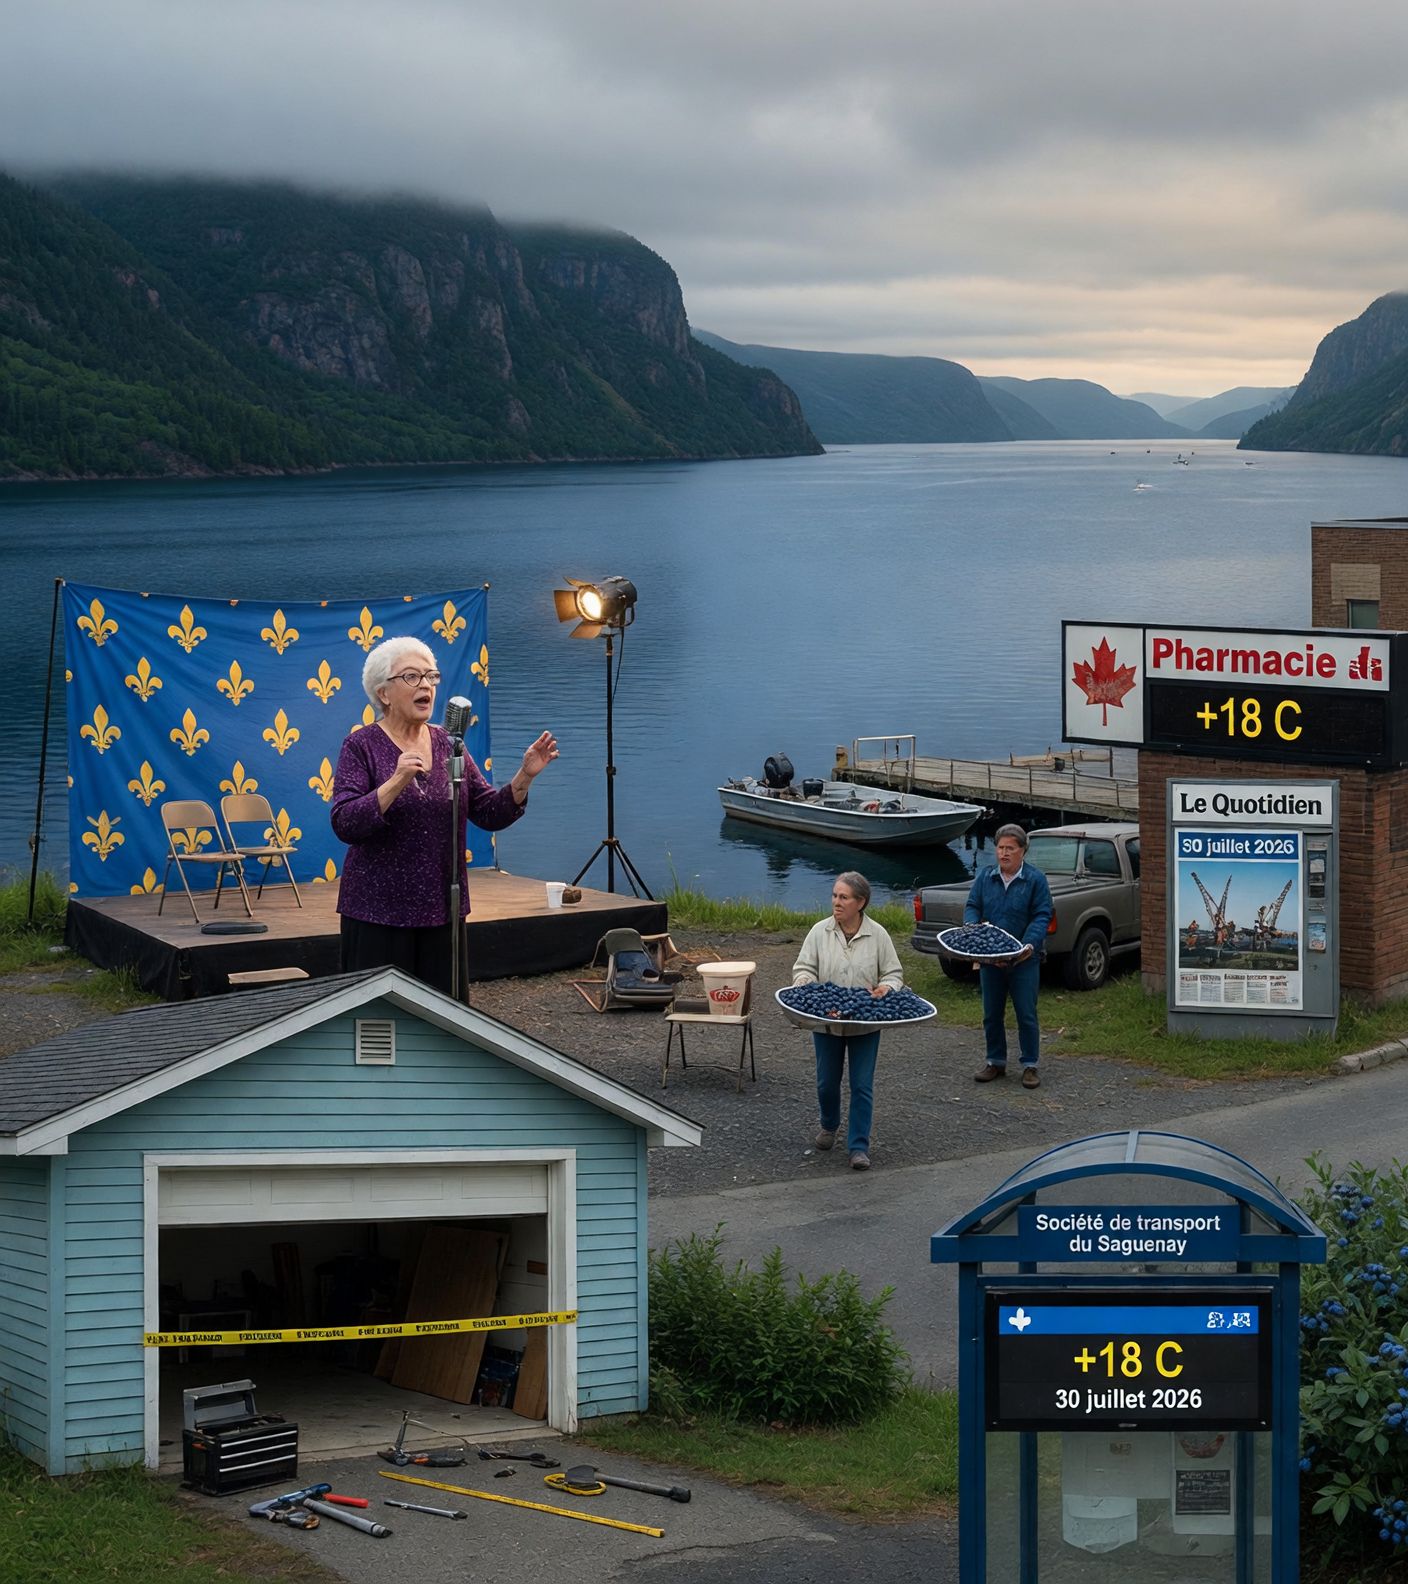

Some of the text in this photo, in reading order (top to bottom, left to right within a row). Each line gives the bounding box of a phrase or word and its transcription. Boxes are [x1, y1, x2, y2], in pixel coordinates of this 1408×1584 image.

[1152, 638, 1337, 678] Pharmacie
[1196, 697, 1303, 741] +18 C
[1180, 792, 1322, 817] Le Quotidien
[1206, 838, 1251, 857] juillet
[1254, 839, 1295, 855] 2026
[1036, 1213, 1221, 1234] Société de transport
[1069, 1234, 1187, 1256] du Saguenay
[1074, 1340, 1184, 1378] +18 C
[1055, 1388, 1202, 1414] 30 juillet 2026
